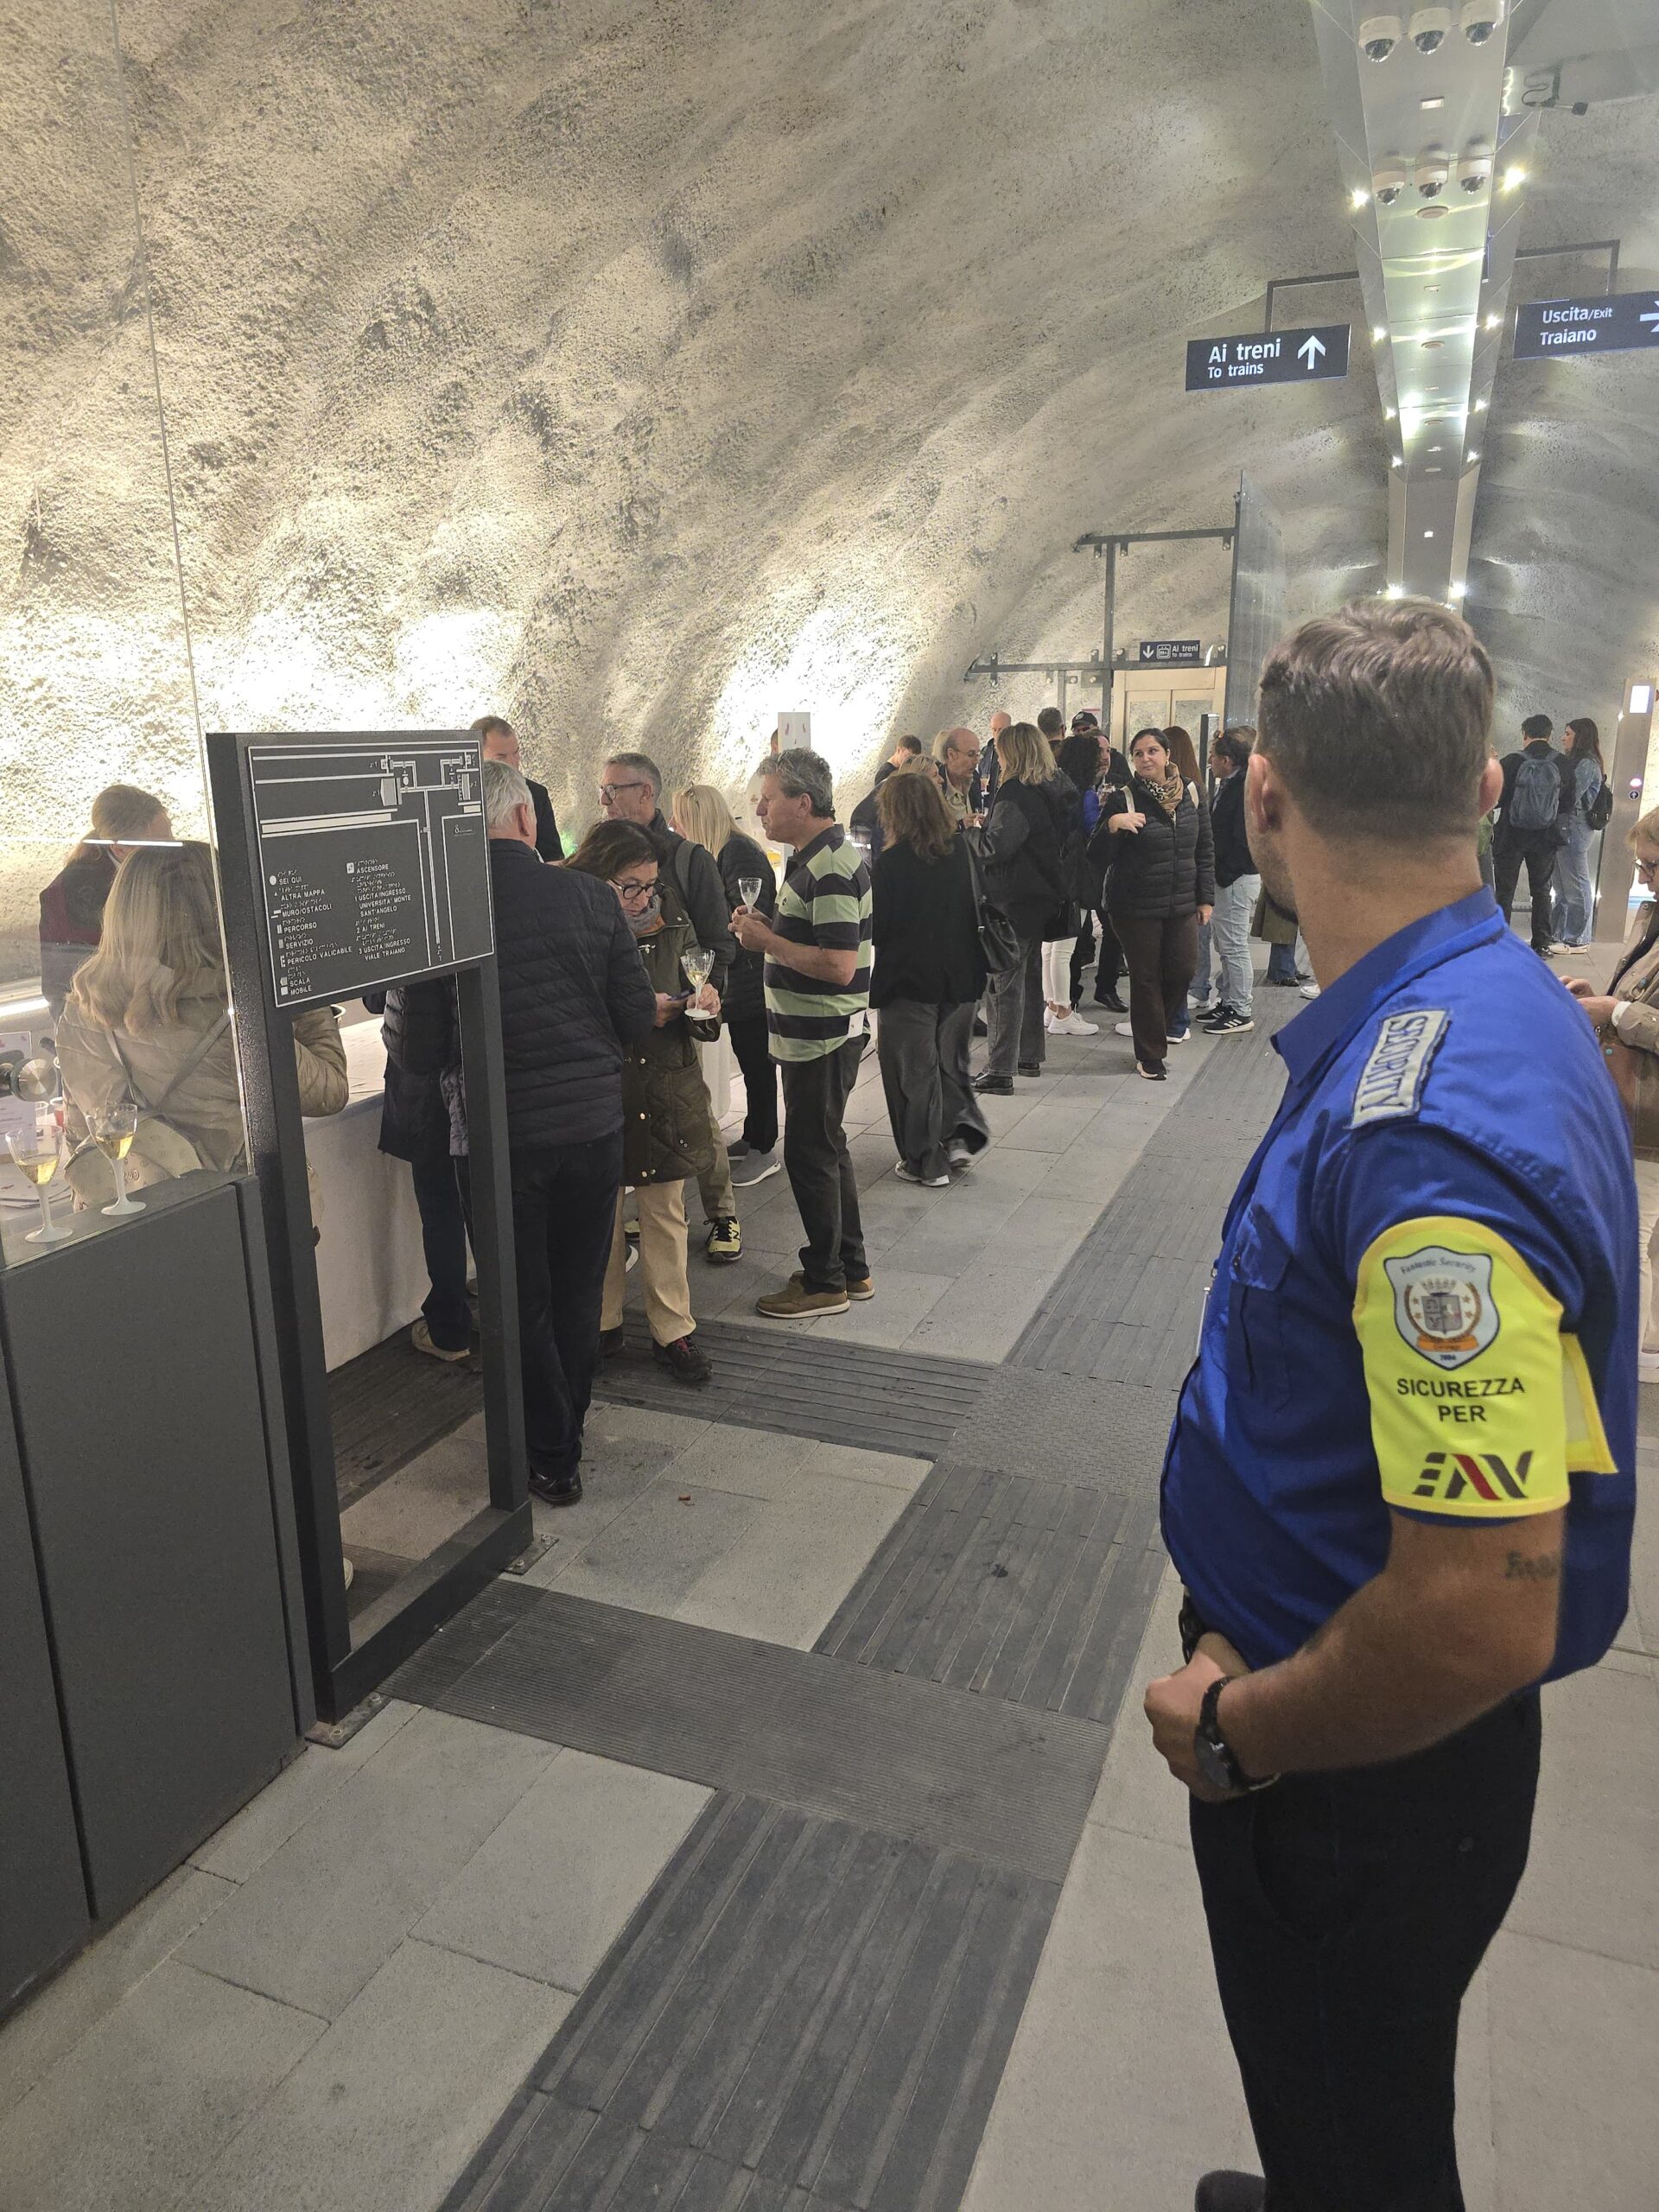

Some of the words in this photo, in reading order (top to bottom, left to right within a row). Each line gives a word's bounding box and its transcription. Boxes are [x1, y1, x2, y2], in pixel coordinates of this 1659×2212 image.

[1542, 307, 1613, 324] Uscita/Exit
[1540, 328, 1598, 346] Traiano
[1208, 343, 1228, 364] Ai
[1236, 338, 1281, 361] treni
[1207, 366, 1222, 379] To
[1228, 362, 1264, 378] trains
[357, 864, 389, 874] ASCENSORE
[281, 893, 302, 902] ALTRA
[303, 888, 326, 899] MAPPA
[393, 894, 411, 903] MONTE
[282, 903, 333, 918] MURO/OSTACOLI
[359, 905, 397, 918] SANT'ANGELO
[283, 921, 317, 933] PERCORSO
[369, 922, 385, 931] TRENI
[285, 938, 314, 950] SERVIZIO
[287, 953, 318, 966] PERICOLO
[319, 945, 353, 959] VALICABILE
[364, 951, 381, 962] VIALE
[382, 946, 406, 957] TRAIANO
[289, 976, 311, 988] SCALA
[290, 984, 313, 996] MOBILE
[1359, 1015, 1428, 1113] SECURITY
[1396, 1377, 1526, 1399] SICUREZZA
[1437, 1404, 1487, 1423] PER
